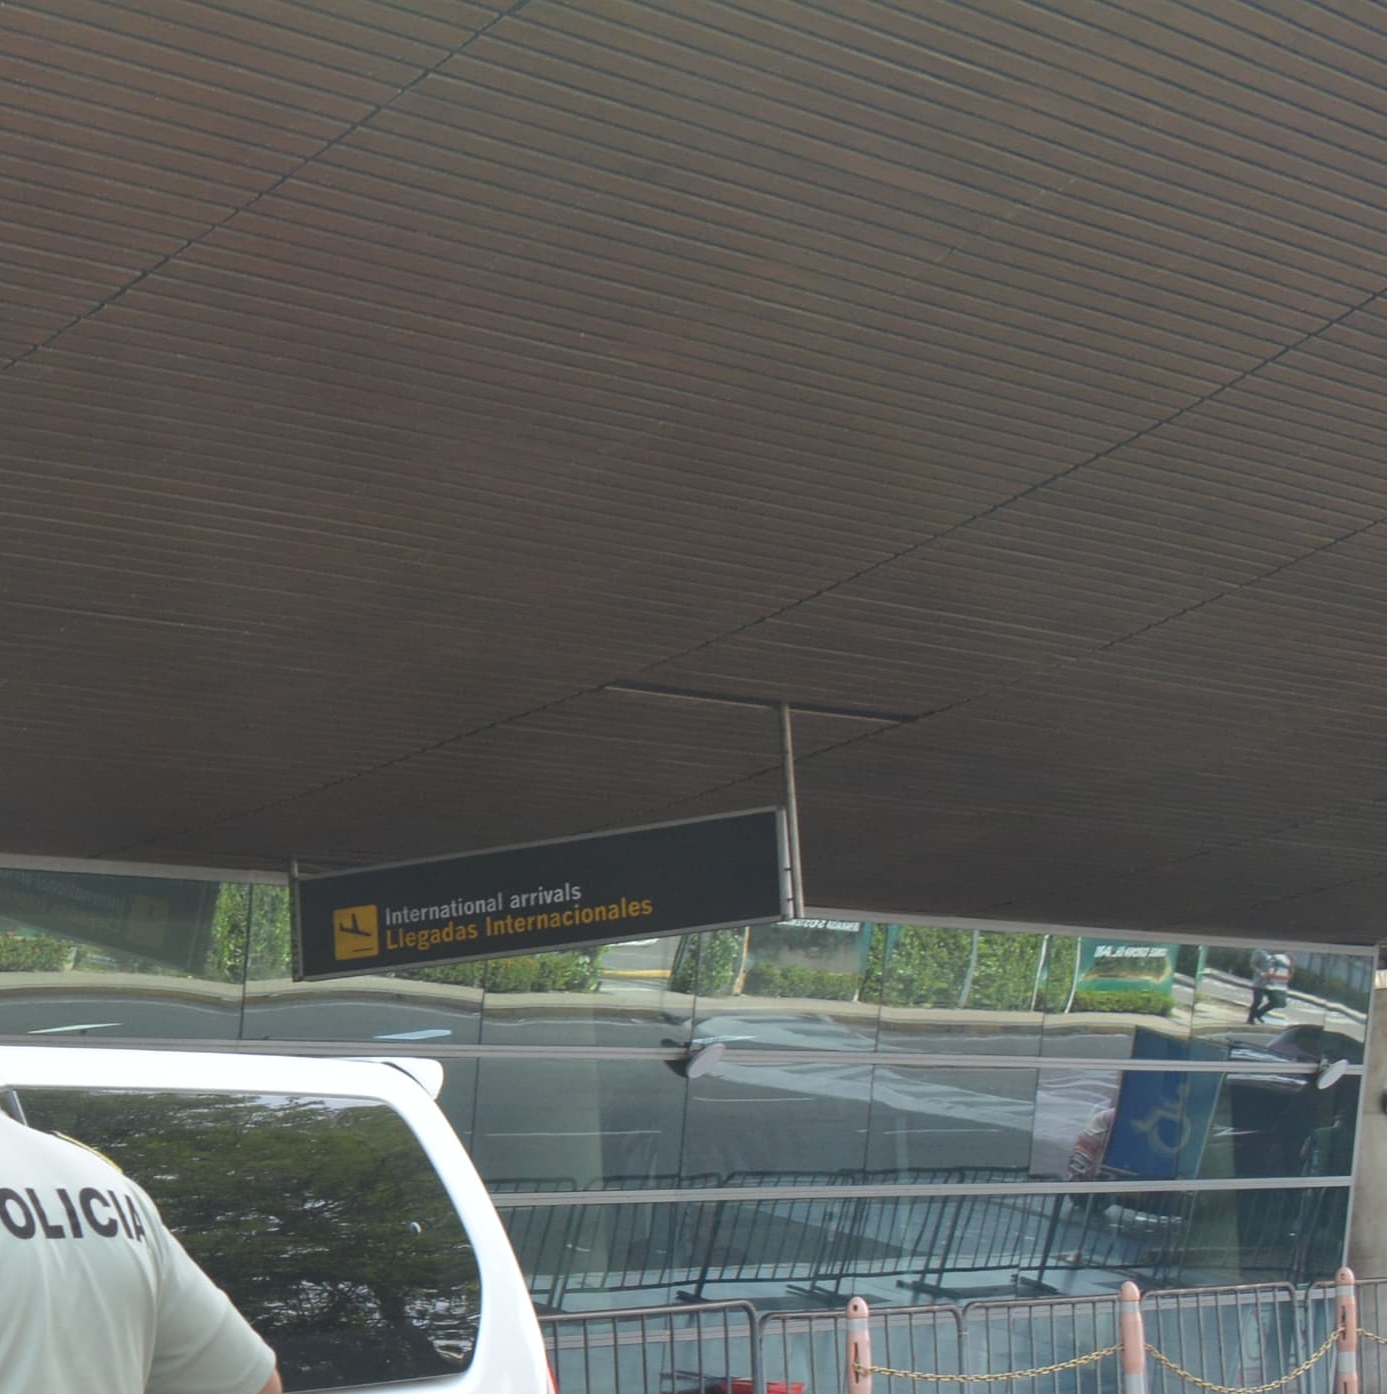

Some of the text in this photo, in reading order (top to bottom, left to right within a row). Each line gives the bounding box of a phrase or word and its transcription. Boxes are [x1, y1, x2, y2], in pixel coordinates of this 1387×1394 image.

[384, 882, 584, 926] International arrivals
[384, 895, 655, 951] Llegadas Internacionales
